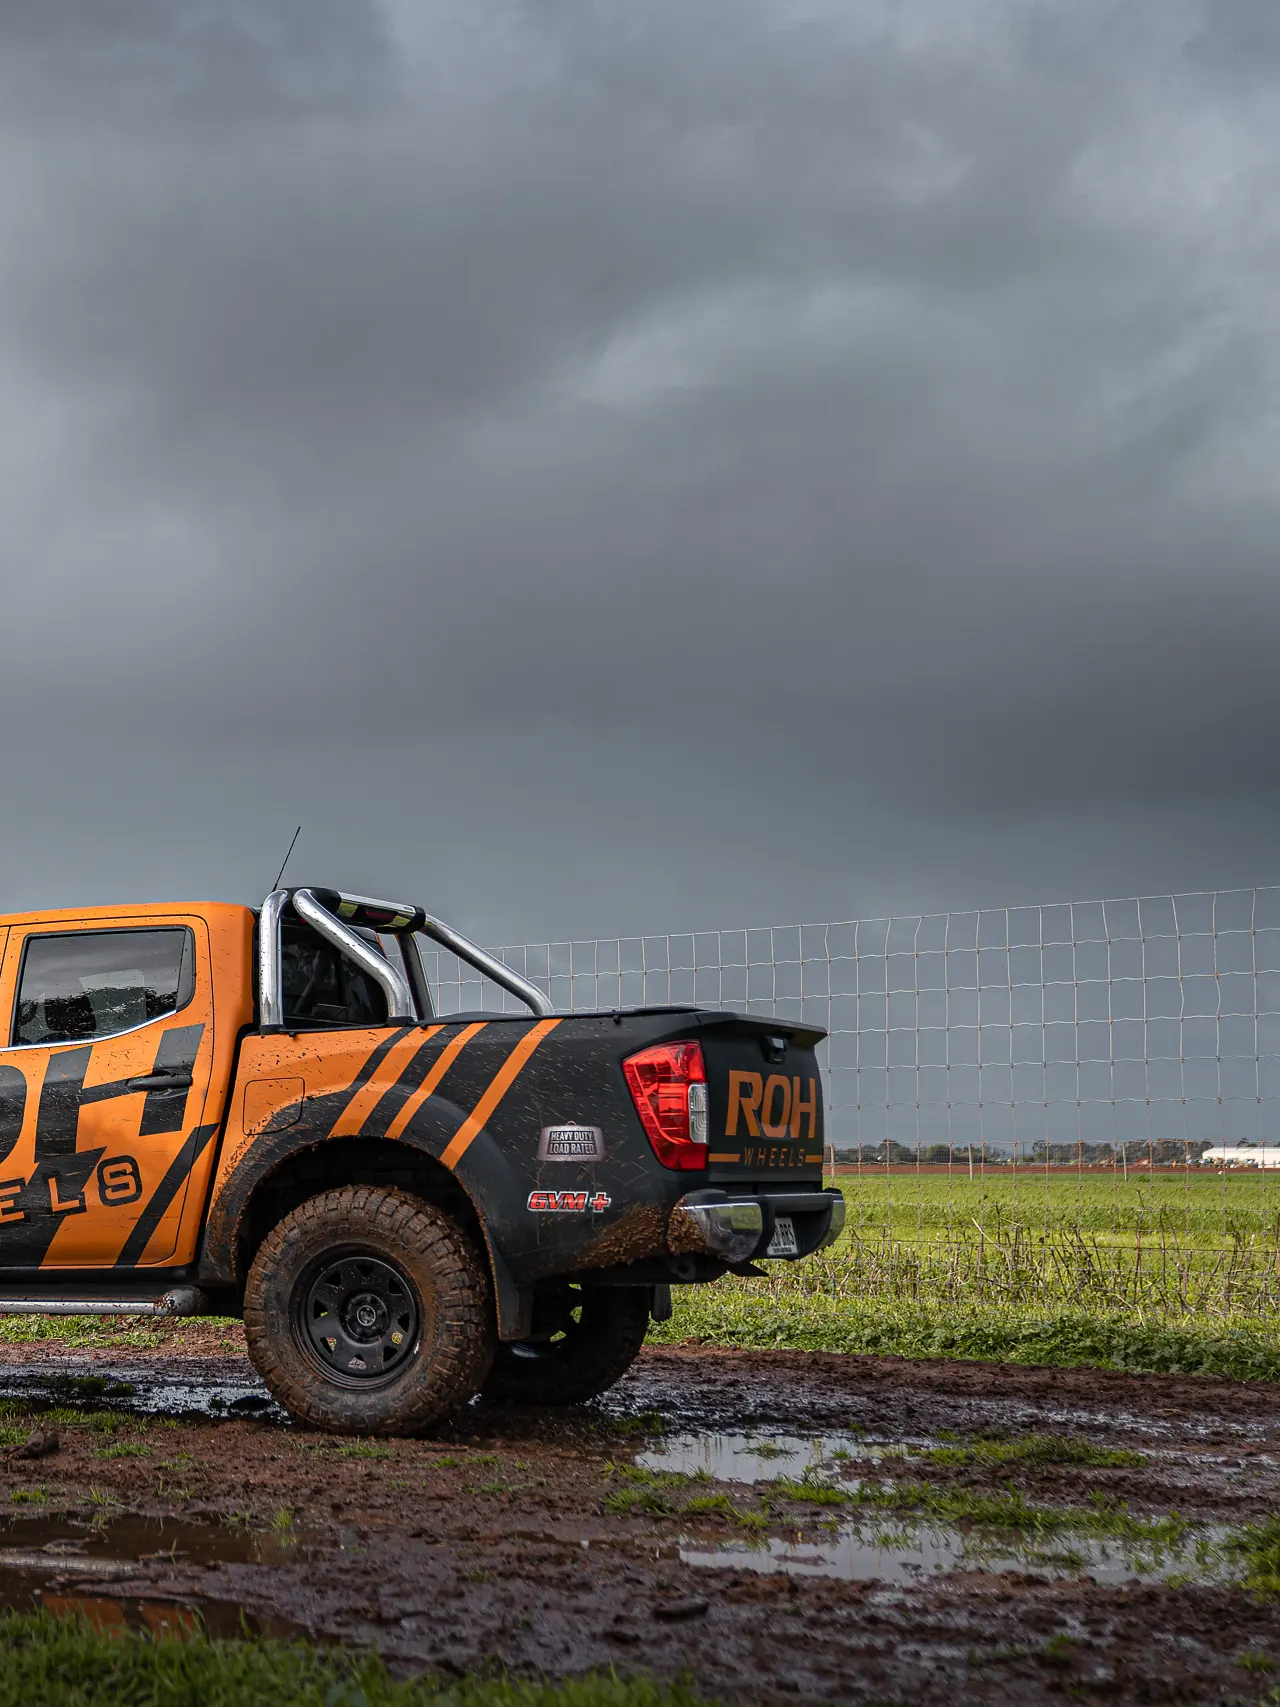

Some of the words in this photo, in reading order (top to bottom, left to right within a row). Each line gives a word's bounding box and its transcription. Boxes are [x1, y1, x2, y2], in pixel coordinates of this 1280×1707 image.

[725, 1069, 816, 1138] ROH
[551, 1131, 573, 1141] HEAVY
[574, 1131, 593, 1141] DUTY
[549, 1143, 569, 1154] LOAD
[571, 1143, 594, 1154] RATED
[744, 1147, 805, 1167] WHEELS
